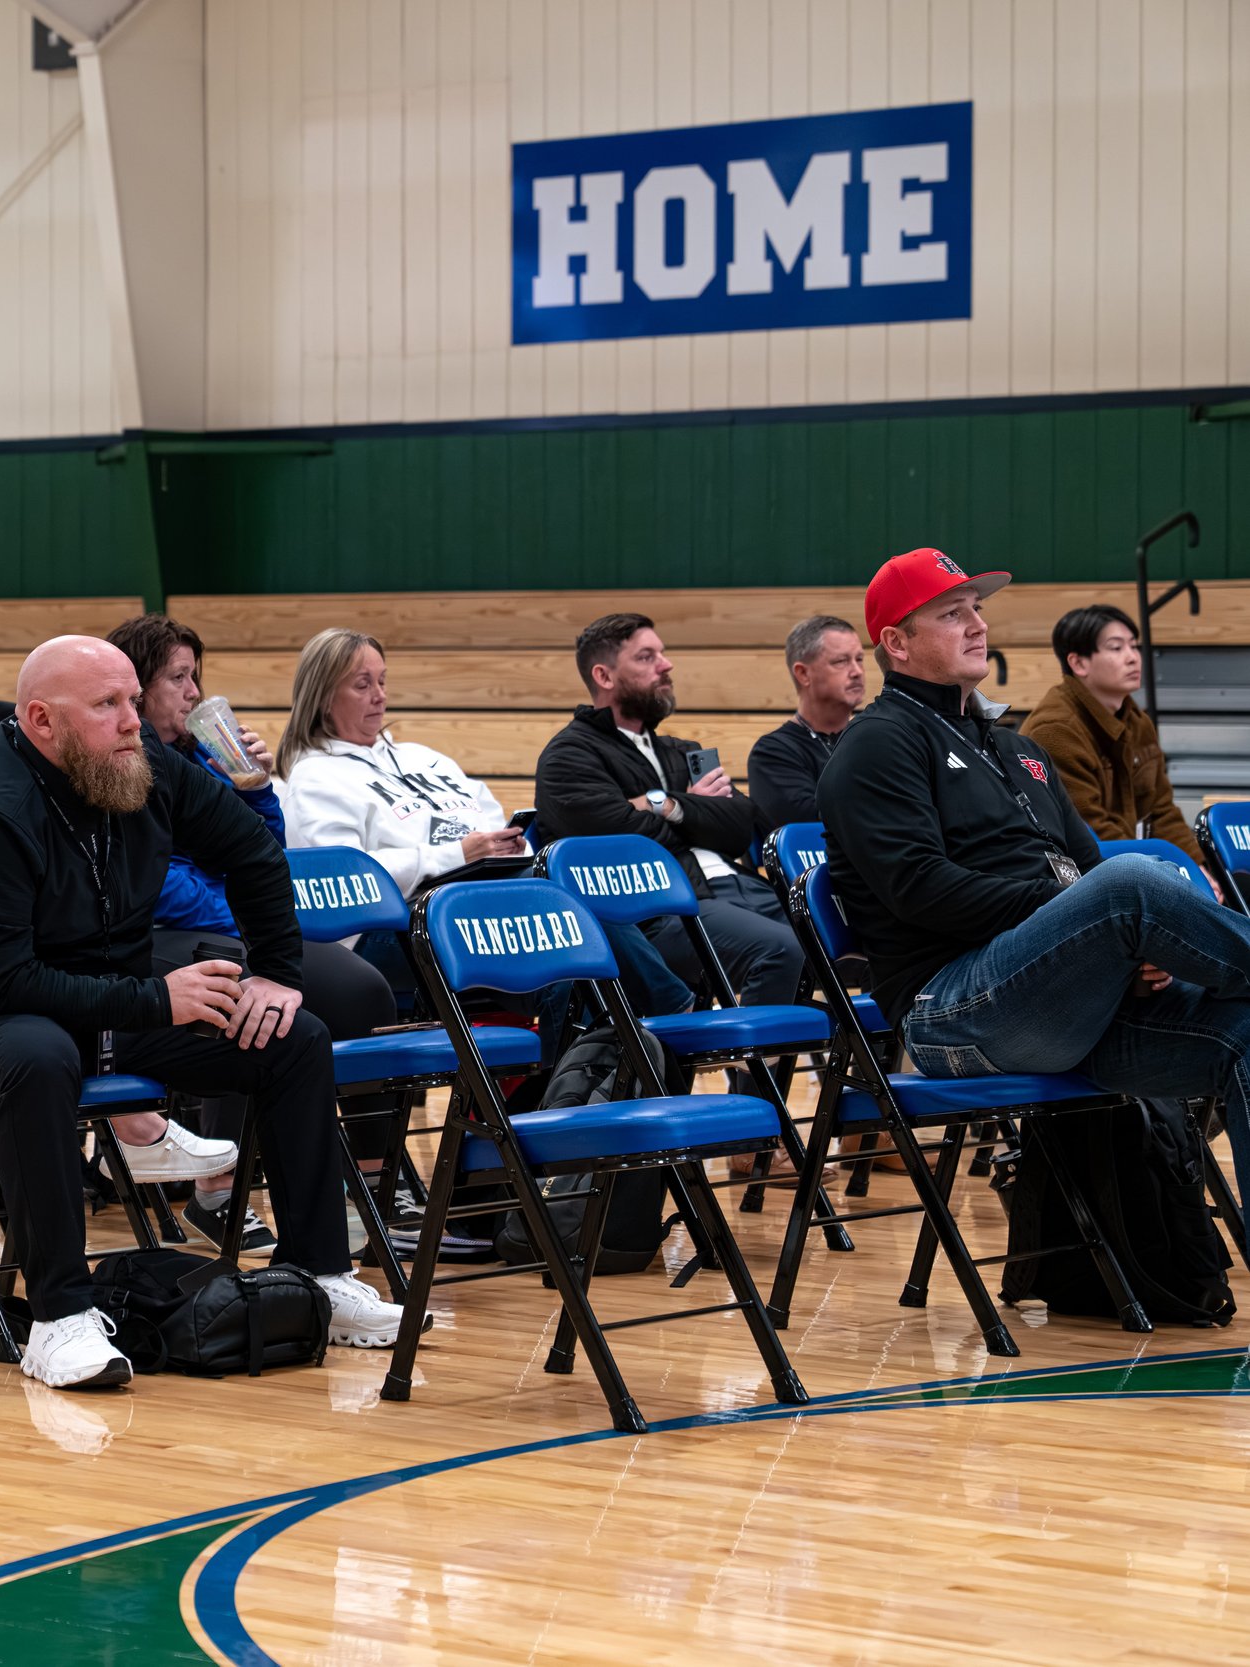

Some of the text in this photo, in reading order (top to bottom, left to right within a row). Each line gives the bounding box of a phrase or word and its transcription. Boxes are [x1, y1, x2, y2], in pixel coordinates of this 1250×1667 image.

[532, 143, 950, 308] HOME
[366, 773, 473, 806] NKE
[292, 872, 382, 910] NGUARD
[570, 860, 671, 897] VANGUARD
[454, 910, 583, 956] VANGUARD
